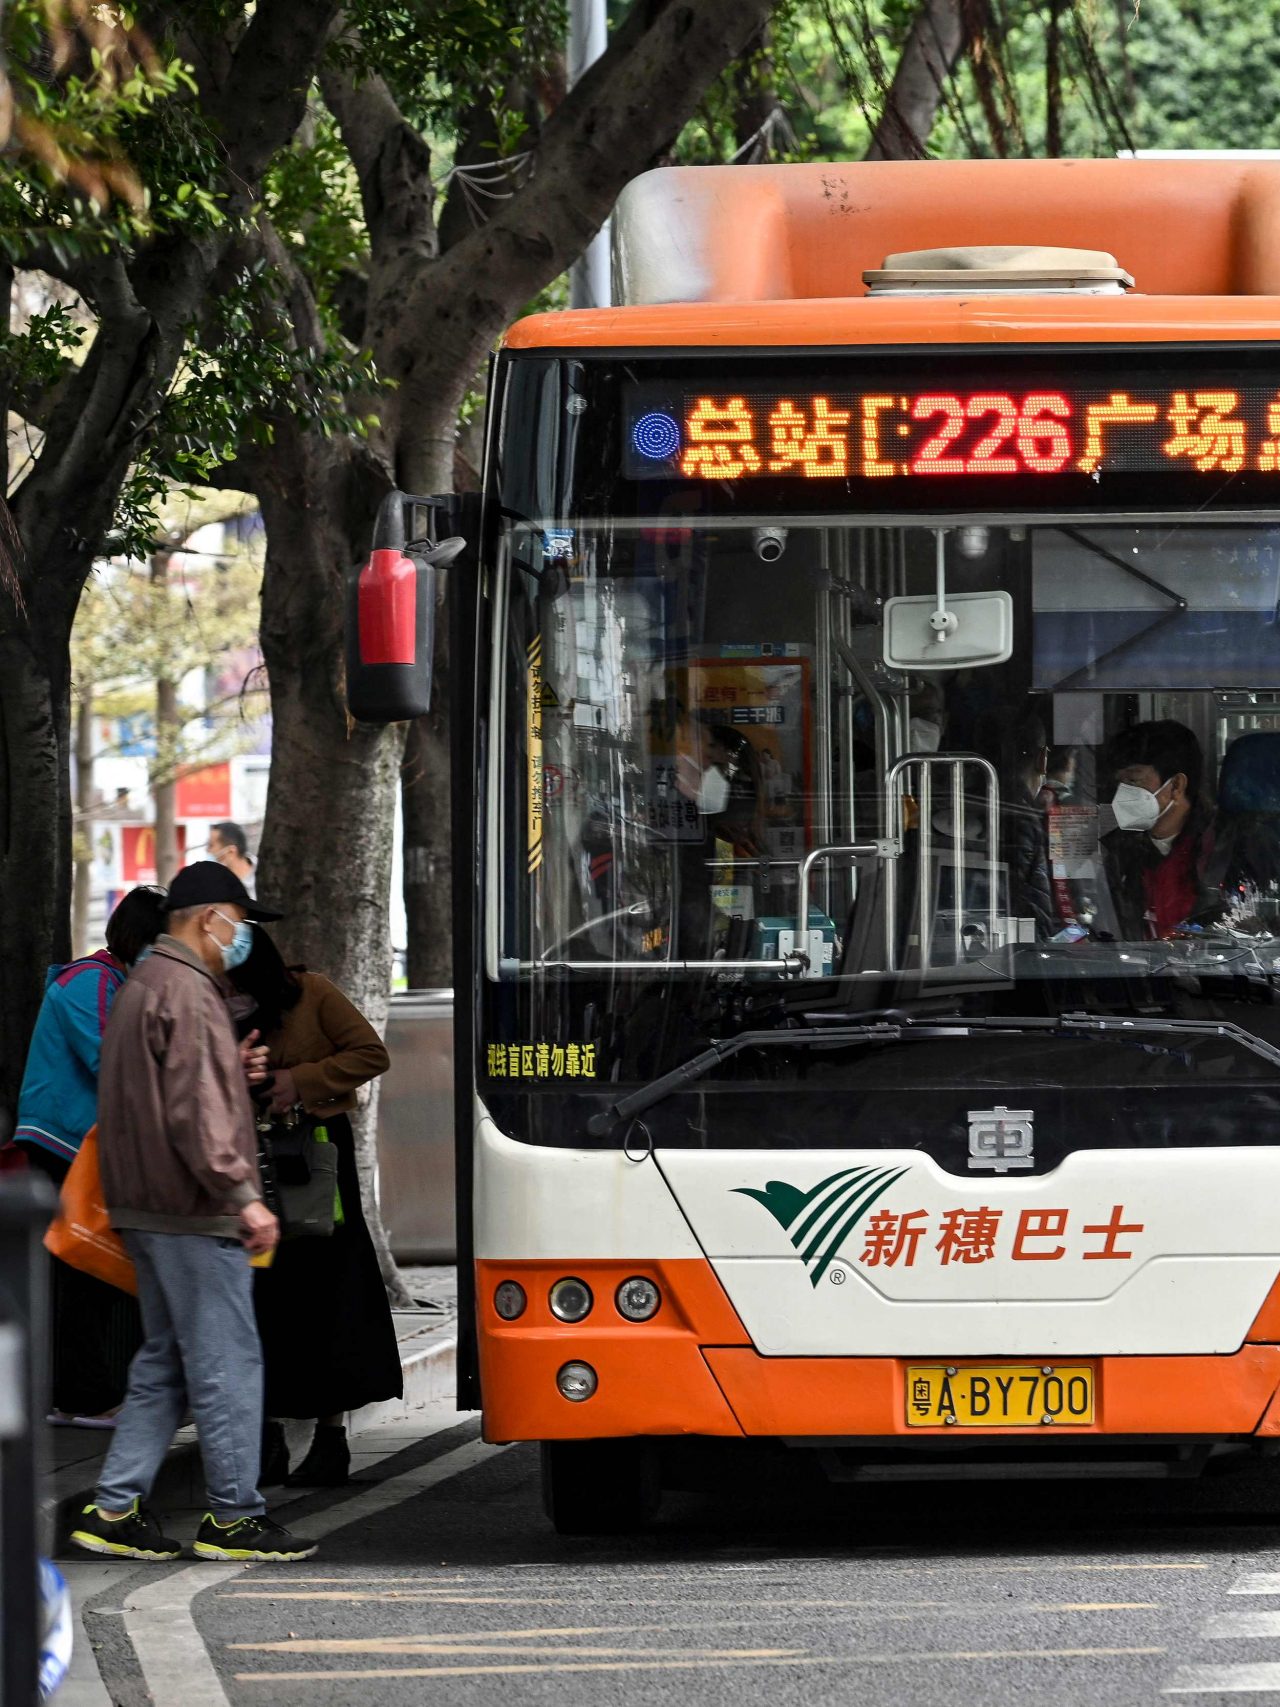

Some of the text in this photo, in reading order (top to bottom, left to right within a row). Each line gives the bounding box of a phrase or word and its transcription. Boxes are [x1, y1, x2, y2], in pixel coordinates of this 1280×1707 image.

[912, 392, 1072, 474] 226
[487, 1043, 597, 1077] 视线盲区请勿靠近
[858, 1205, 1145, 1267] 新穗巴士
